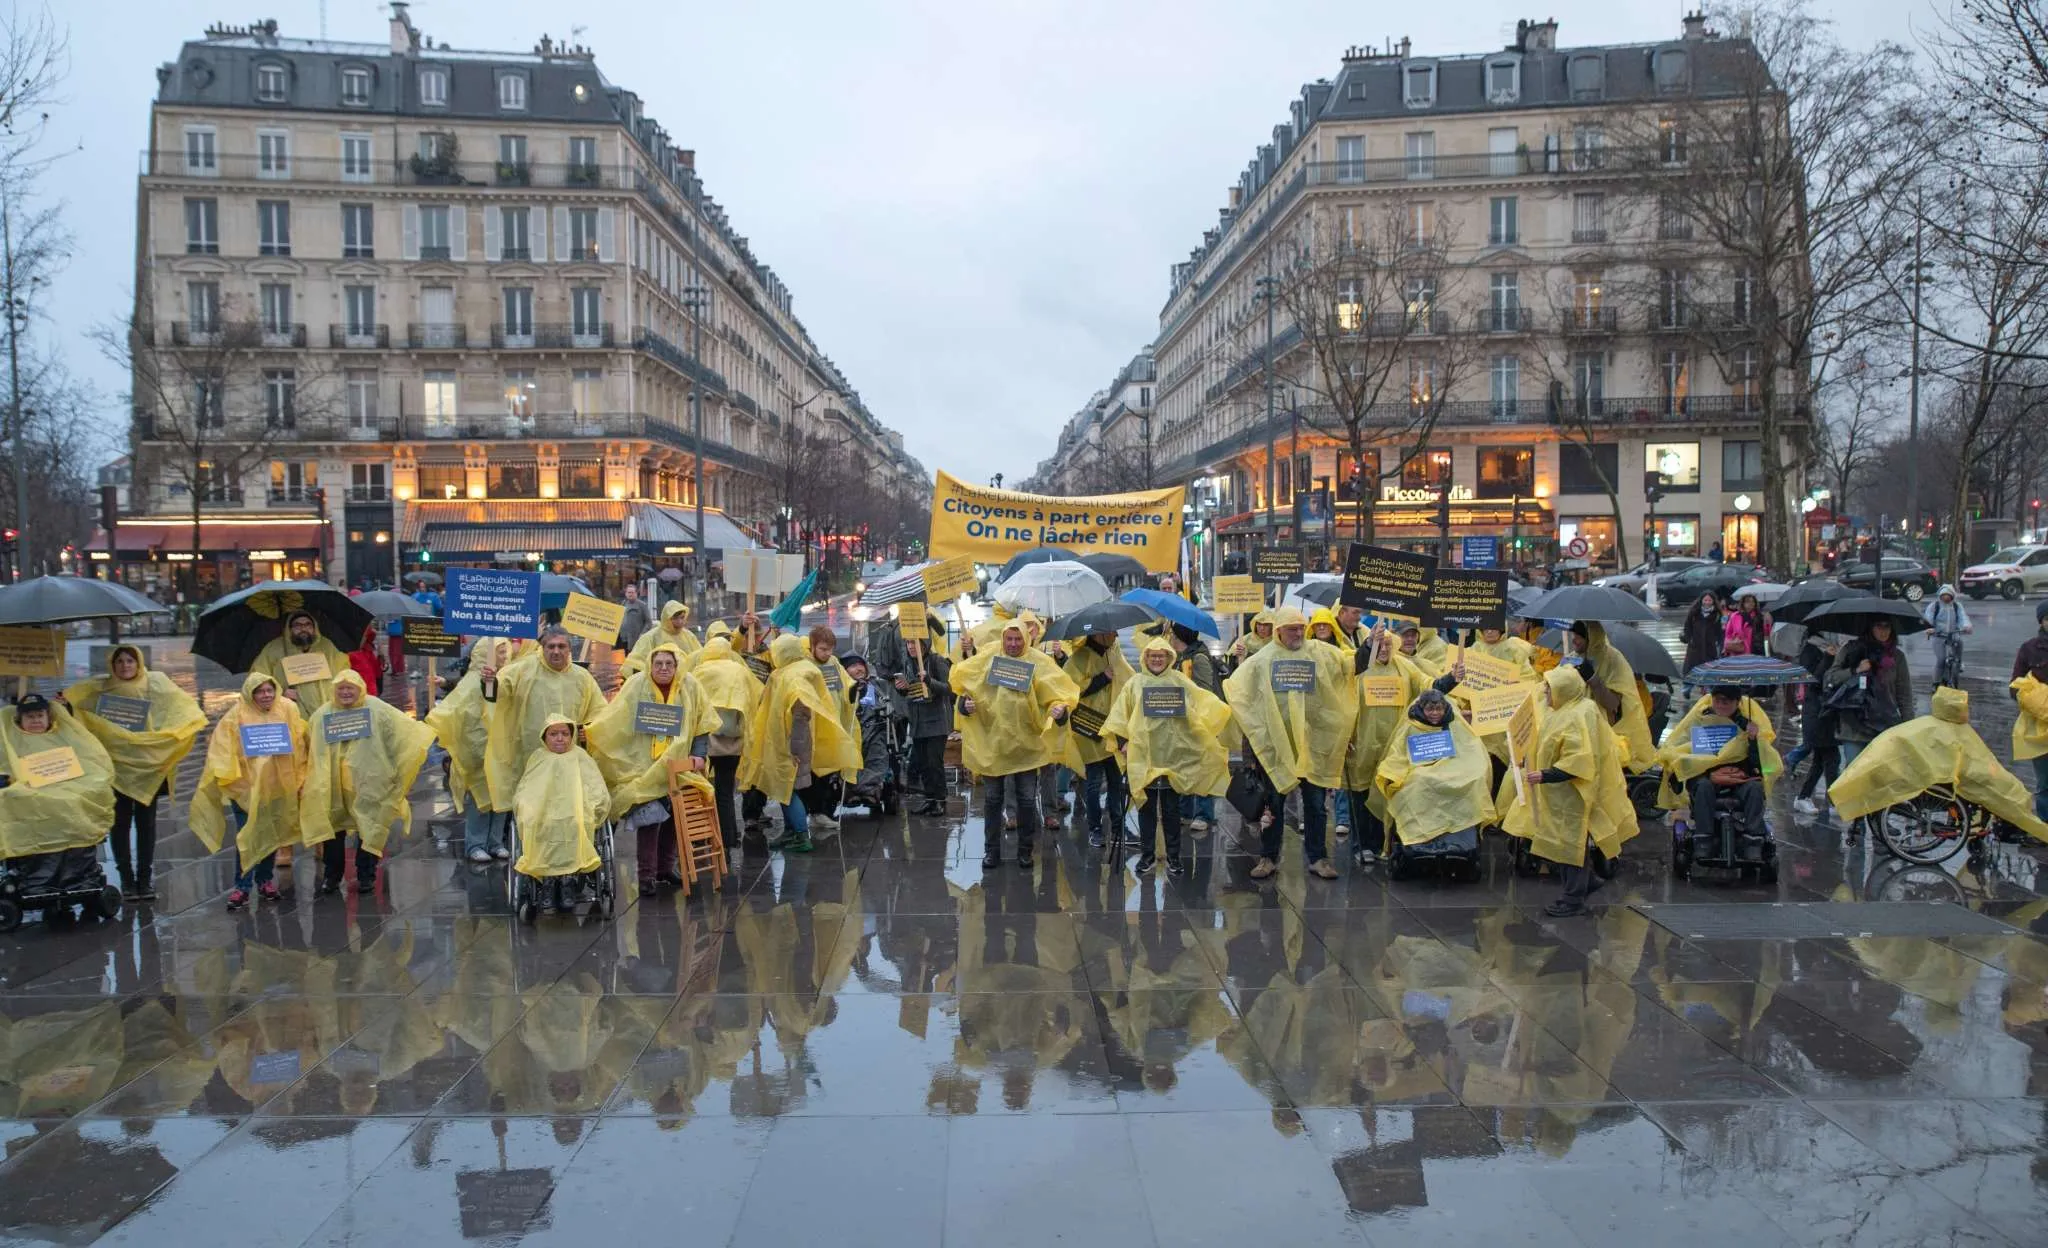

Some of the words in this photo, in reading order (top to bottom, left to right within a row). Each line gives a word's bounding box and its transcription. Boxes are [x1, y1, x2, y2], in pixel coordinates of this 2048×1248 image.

[944, 498, 1027, 520] Citoyens
[1033, 508, 1044, 521] à
[1050, 511, 1090, 526] part
[1096, 511, 1162, 526] entière
[1168, 512, 1174, 526] !
[966, 520, 998, 538] On
[1005, 526, 1032, 541] ne
[1040, 525, 1098, 544] lâche
[1104, 528, 1148, 546] rien
[1360, 556, 1425, 574] #LaRepublique
[1360, 564, 1422, 580] CestNousAussi
[459, 574, 528, 586] #LaRepublique
[1358, 574, 1394, 586] République
[1434, 580, 1496, 588] #LaRepublique
[460, 583, 527, 594] CestNousAussi
[1434, 586, 1495, 595] CestNousAussi
[460, 593, 477, 601] Stop
[475, 602, 517, 611] combattant
[451, 610, 473, 620] Non
[475, 610, 482, 620] à
[484, 611, 493, 621] la
[495, 612, 532, 624] fatalité
